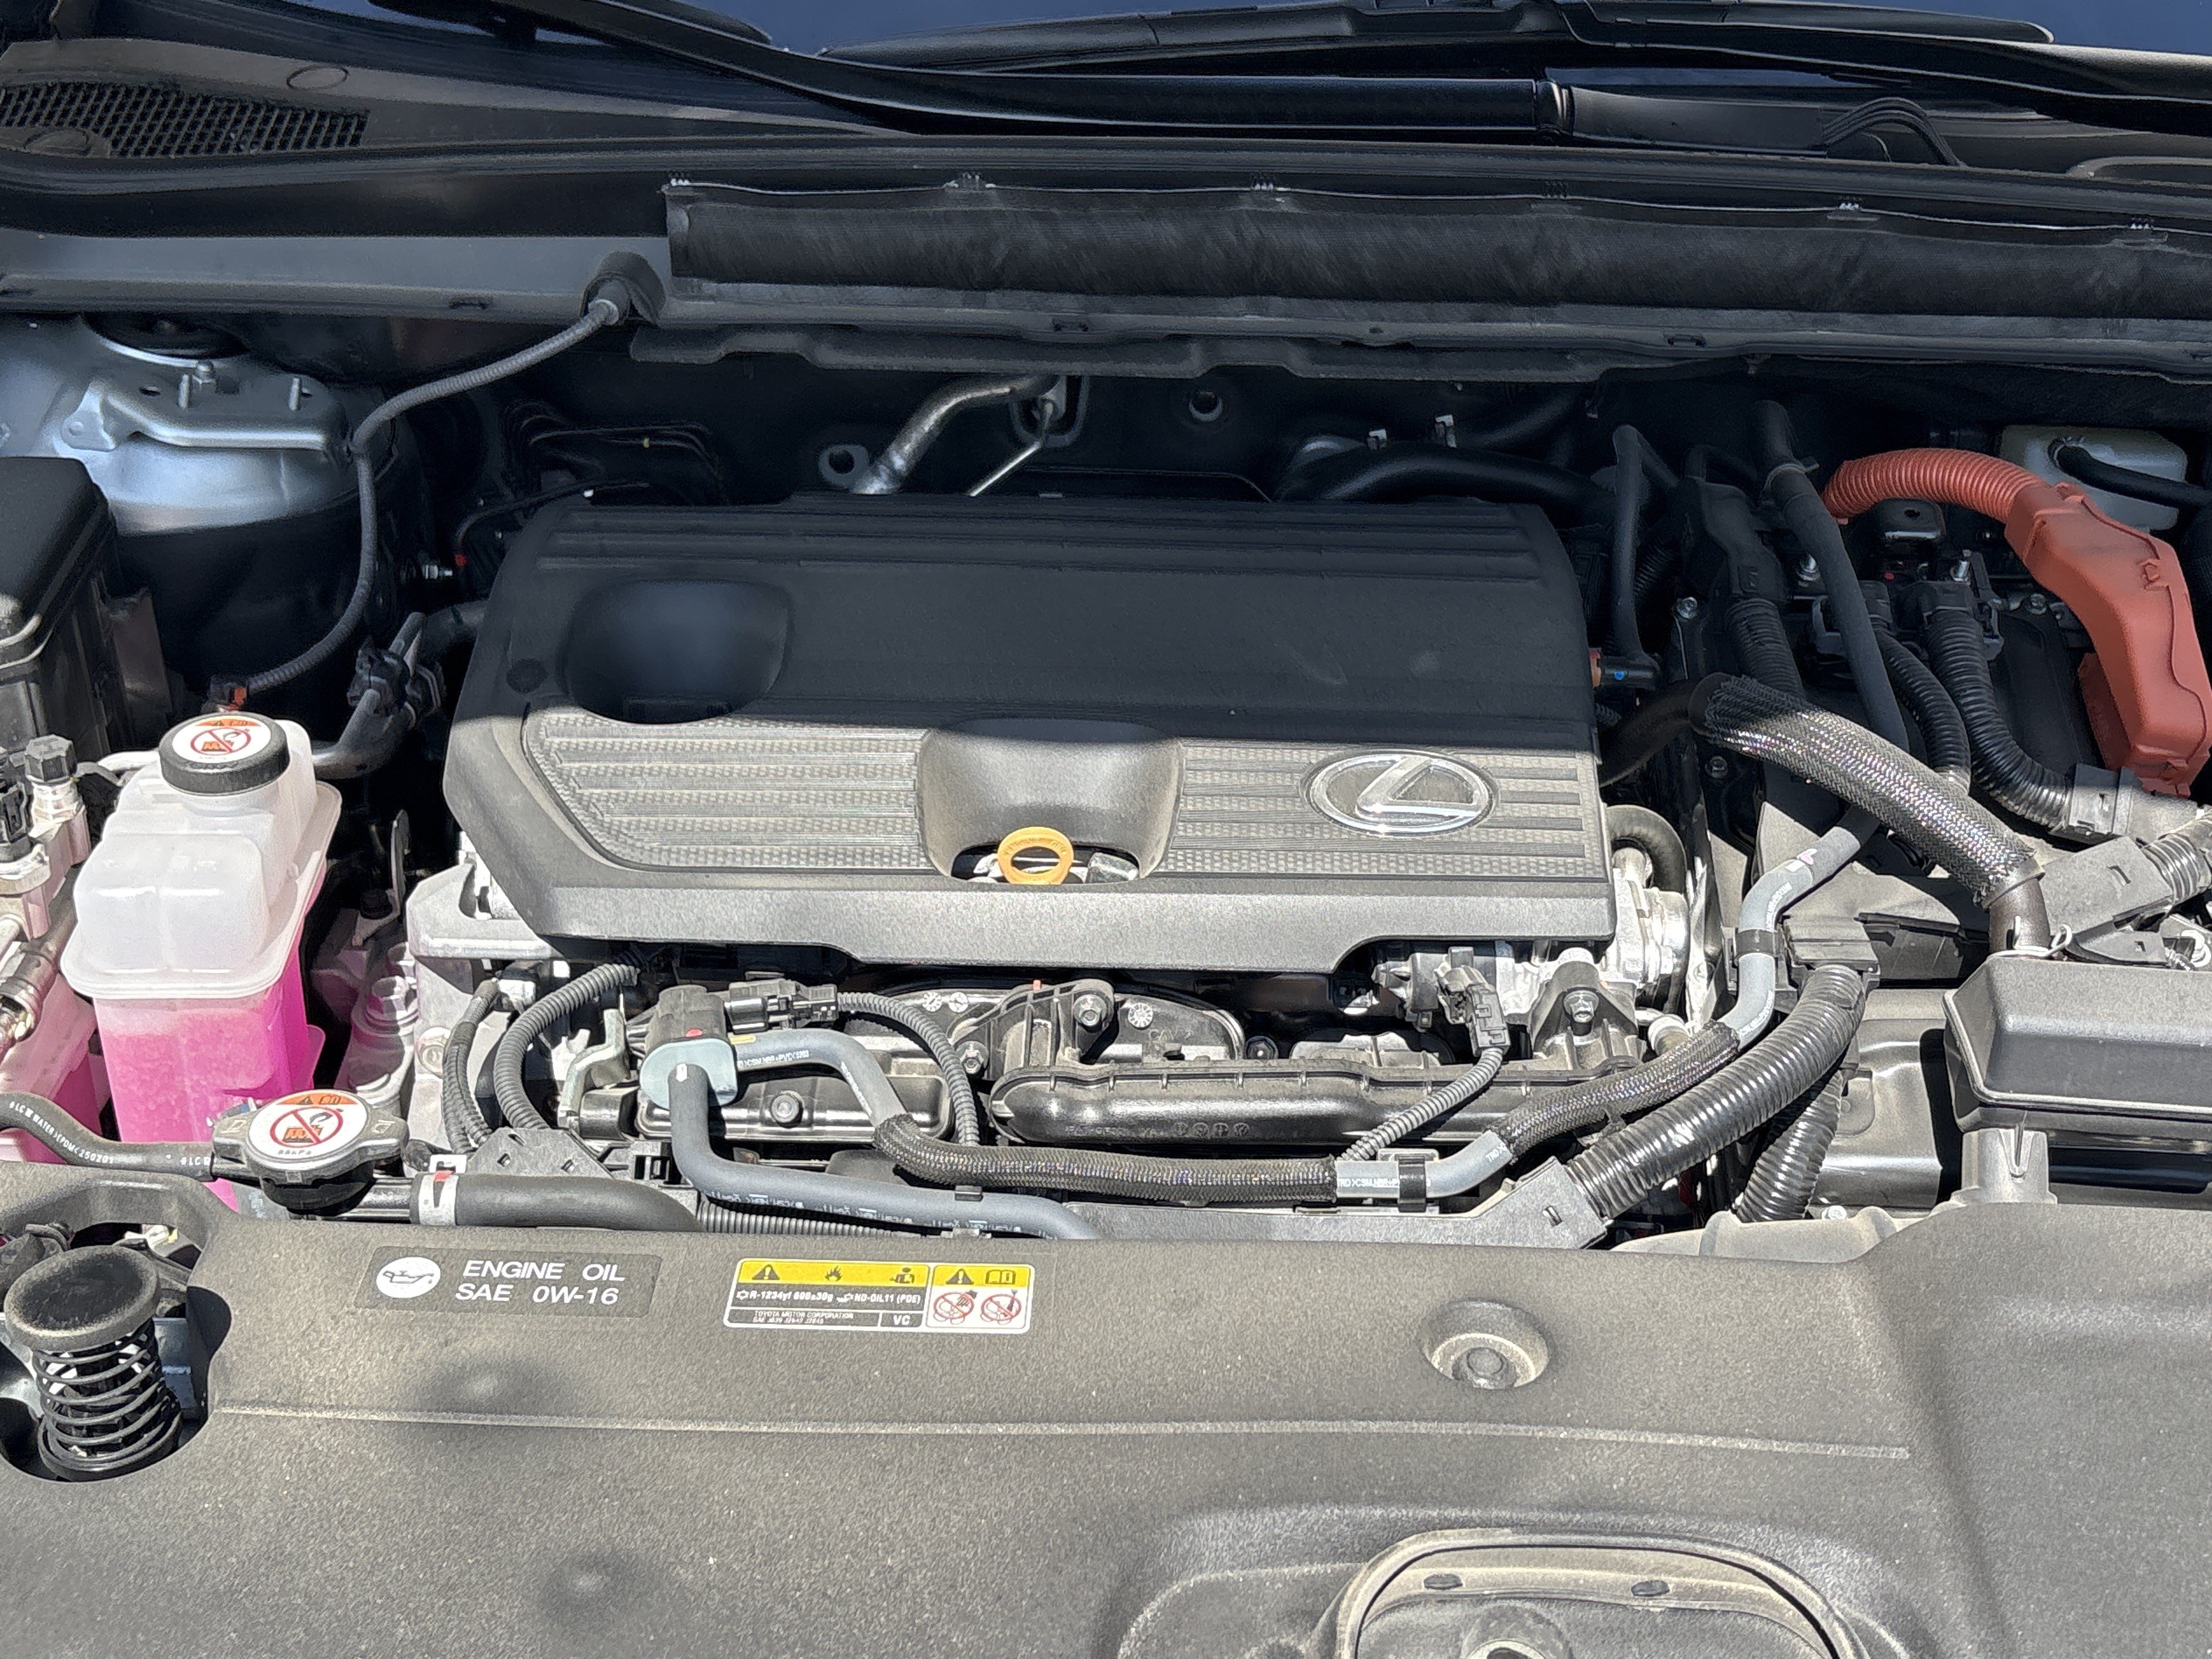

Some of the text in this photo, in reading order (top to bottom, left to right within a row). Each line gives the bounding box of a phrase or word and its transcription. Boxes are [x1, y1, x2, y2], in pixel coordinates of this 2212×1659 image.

[32, 1113, 55, 1135] WATER
[462, 1260, 625, 1281] ENGINE OIL
[455, 1283, 619, 1305] SAE 0W-16
[749, 1290, 793, 1301] R-1234yf
[807, 1311, 854, 1319] CORPORATION
[893, 1314, 911, 1325] VC
